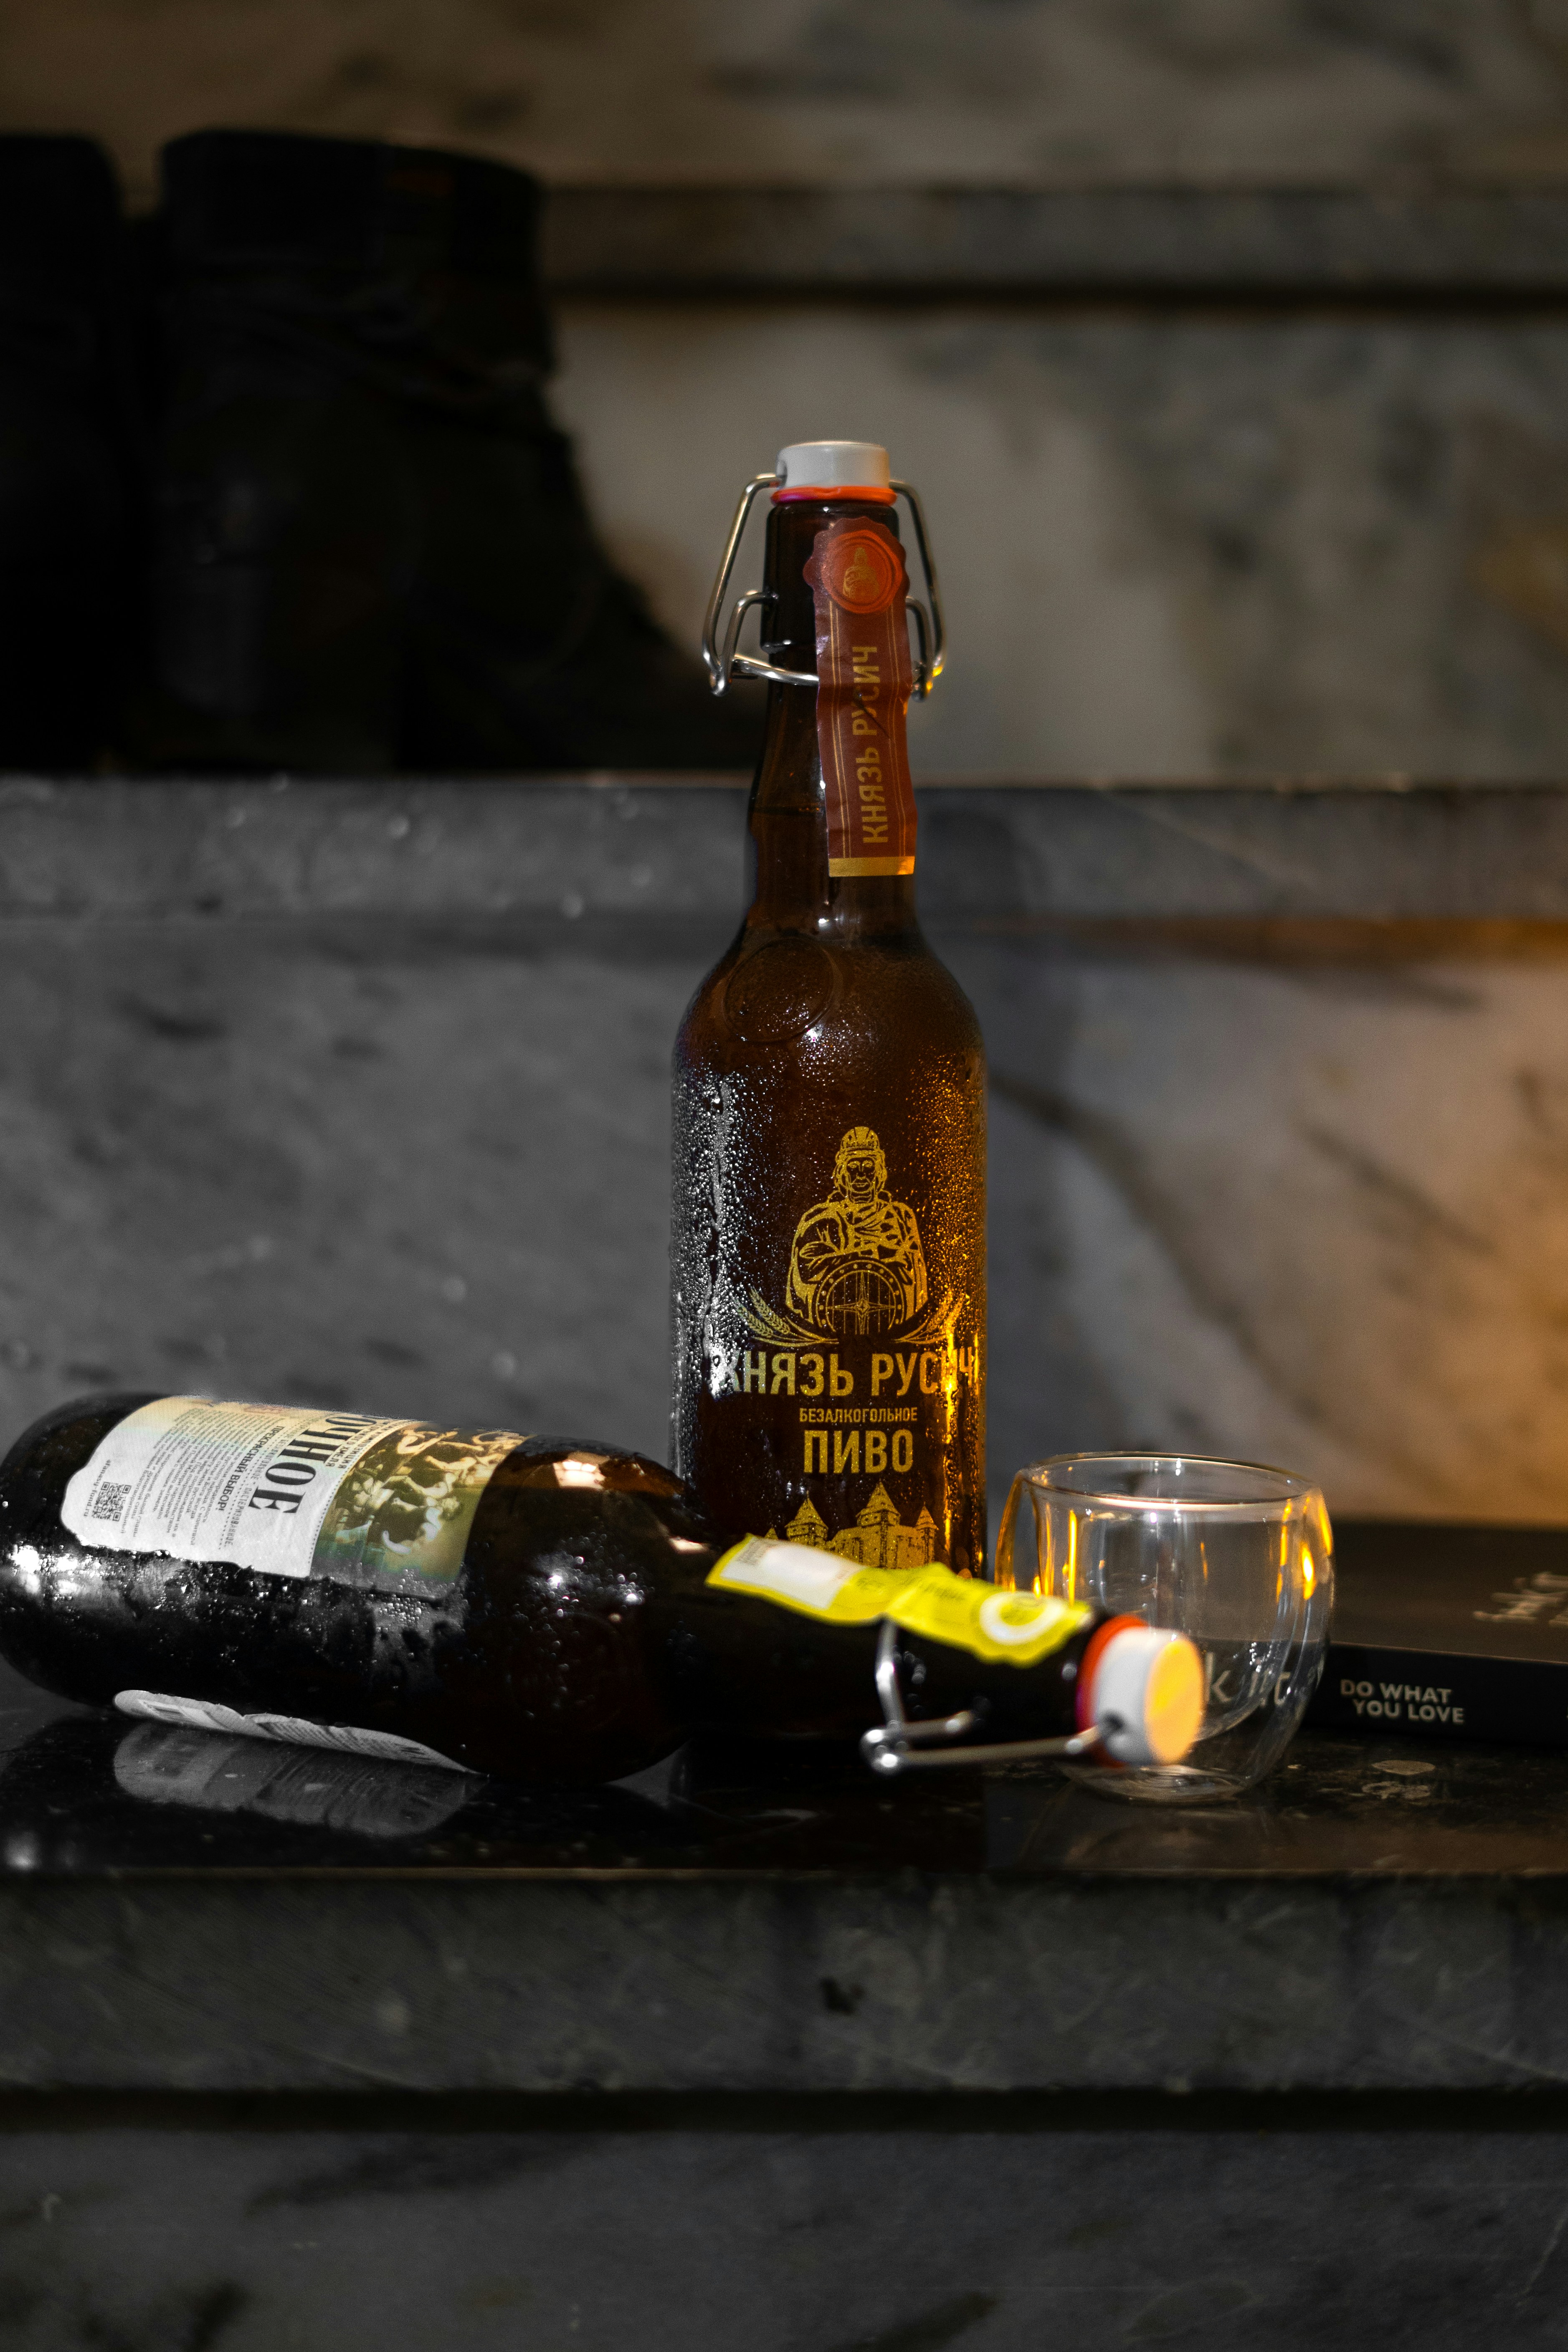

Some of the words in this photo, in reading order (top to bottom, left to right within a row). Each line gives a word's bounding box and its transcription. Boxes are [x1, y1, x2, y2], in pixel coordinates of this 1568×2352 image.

[856, 747, 888, 843] КНЯЗЬ
[871, 1347, 973, 1396] РУСИЧ
[799, 1407, 918, 1423] БЕЗАЛКОГОЛЬНОЕ
[146, 1443, 167, 1468] основали
[207, 1449, 224, 1467] защиту
[219, 1448, 232, 1460] свои
[233, 1425, 286, 1473] ПРЕКРАСНЫЙ
[324, 1446, 351, 1467] ХМЕЛЯ
[803, 1429, 914, 1473] ПИВО
[147, 1453, 172, 1491] возрождение
[162, 1468, 175, 1487] наших
[171, 1450, 197, 1483] Пожарского
[176, 1464, 193, 1486] Матери
[189, 1461, 202, 1473] Под
[195, 1460, 208, 1474] веры
[197, 1468, 210, 1486] земли
[209, 1461, 222, 1476] силы
[213, 1456, 232, 1480] русского
[220, 1461, 236, 1477] эпохи
[83, 1459, 113, 1517] afanasy-fond.ru
[137, 1471, 154, 1500] духовной
[176, 1475, 198, 1521] сопровождали
[199, 1481, 210, 1496] Бога
[215, 1474, 241, 1511] ВЫБОР!
[120, 1470, 149, 1534] Благотворительный
[131, 1501, 140, 1519] силы
[138, 1493, 151, 1514] былой
[157, 1484, 174, 1519] вытеснило
[163, 1486, 180, 1518] народное
[166, 1473, 193, 1533] покровительством
[190, 1497, 202, 1519] всегда
[202, 1478, 225, 1523] определялось
[132, 1515, 142, 1537] славы
[190, 1512, 203, 1545] молитвой
[1340, 1679, 1374, 1696] DO
[1379, 1682, 1452, 1704] WHAT
[1353, 1698, 1401, 1719] YOU
[1408, 1704, 1464, 1724] LOVE
